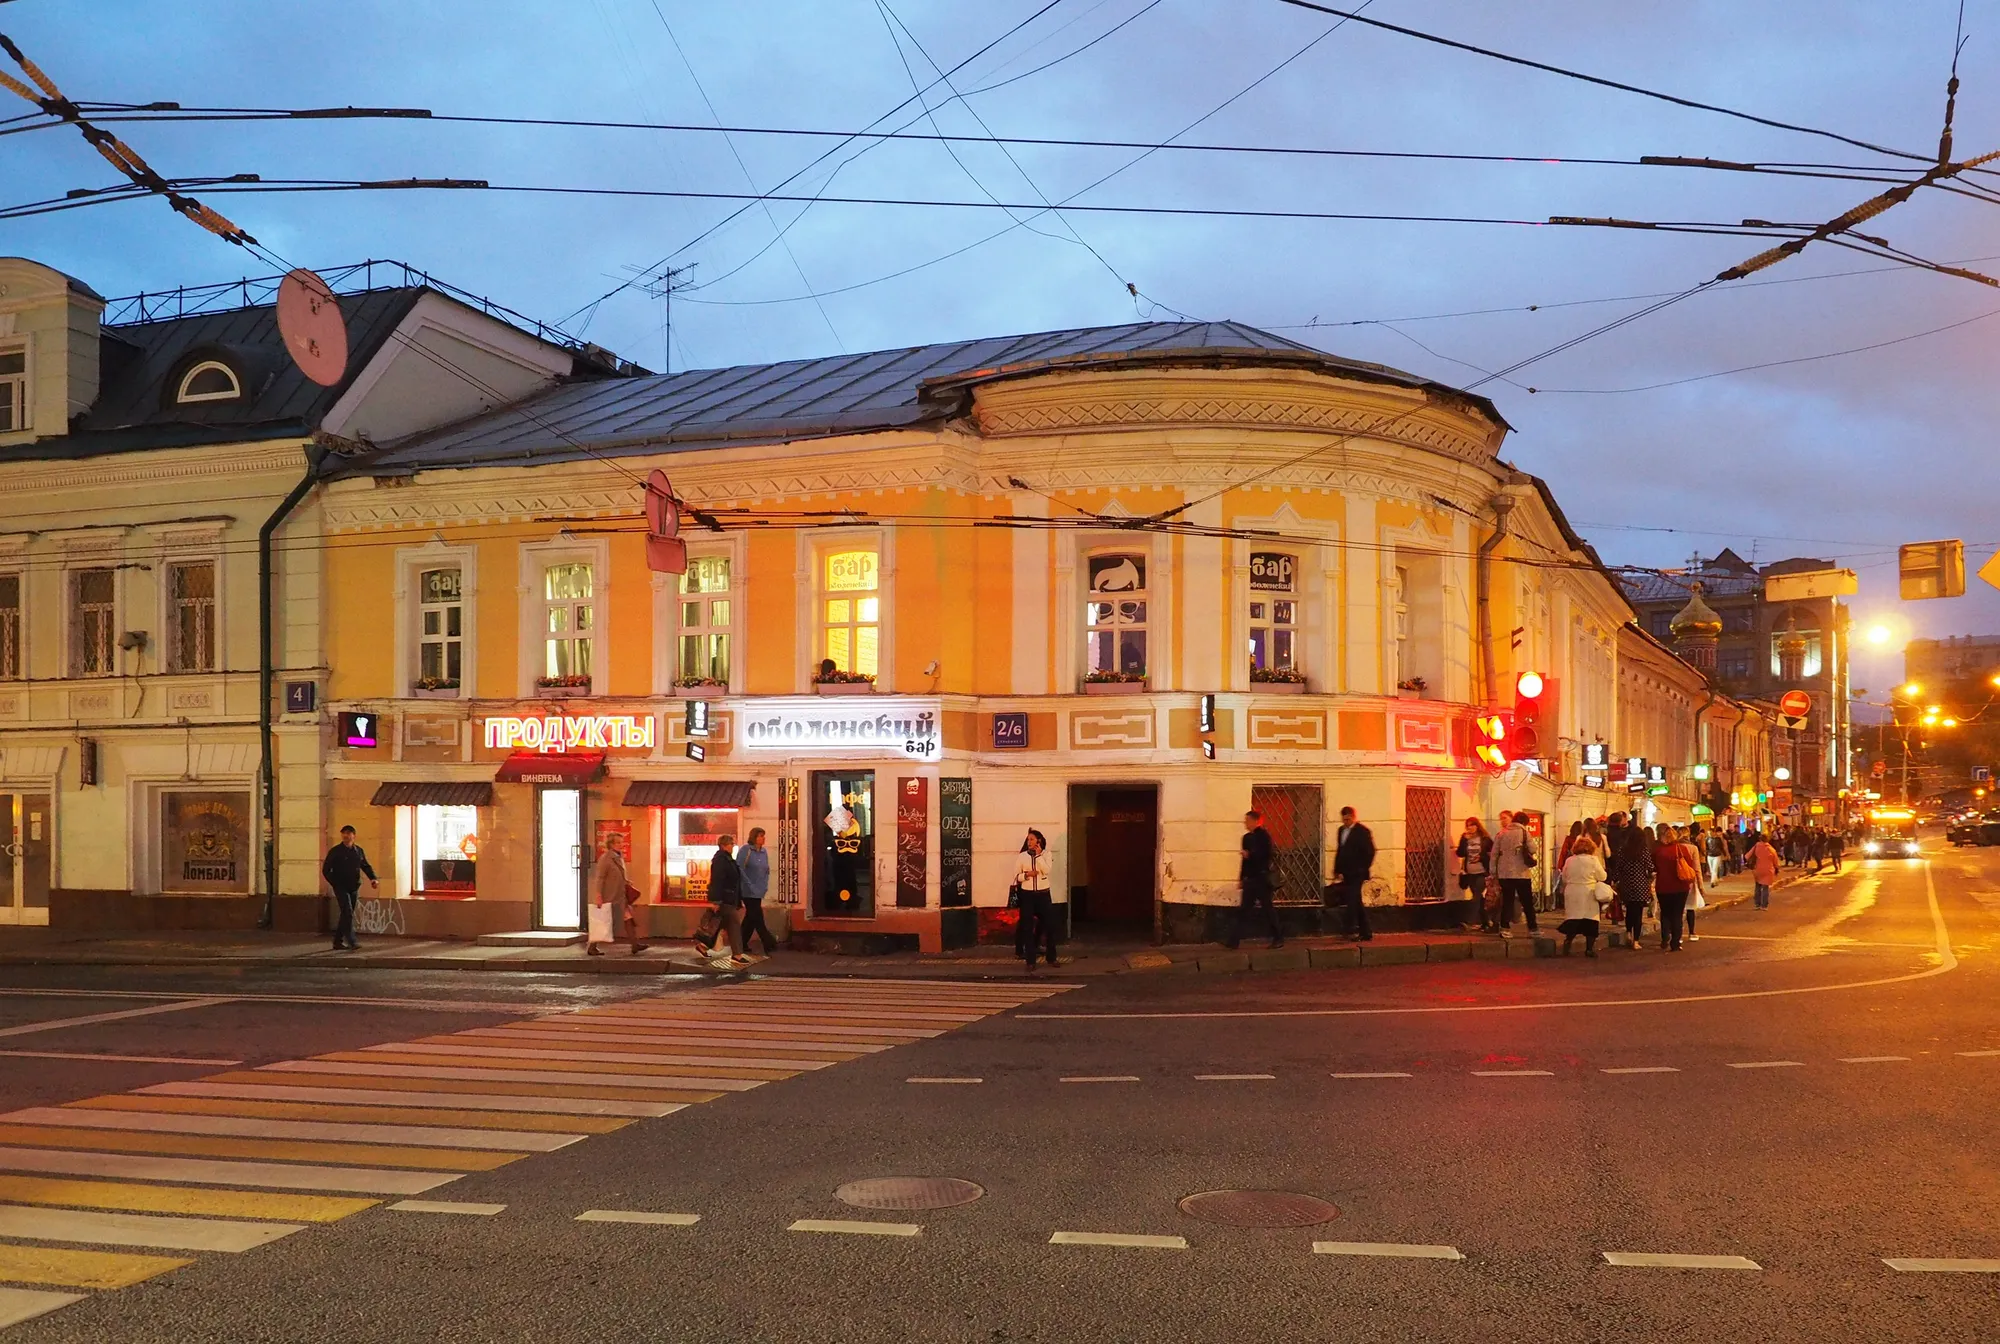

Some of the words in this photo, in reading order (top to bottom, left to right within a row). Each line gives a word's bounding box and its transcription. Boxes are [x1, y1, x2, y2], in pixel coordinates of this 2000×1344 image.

[833, 554, 871, 580] бар
[1252, 556, 1292, 582] бар
[293, 687, 303, 702] 4
[485, 716, 656, 753] ПРОДУКТЫ
[748, 712, 937, 740] оболенский
[997, 720, 1022, 737] 2/6
[905, 738, 935, 756] бар
[521, 774, 563, 783] ВИНОТЕКА
[942, 781, 970, 792] ЗАВТРАК
[788, 778, 798, 803] БАР
[942, 816, 969, 831] ОБЕД
[687, 860, 710, 878] ФО
